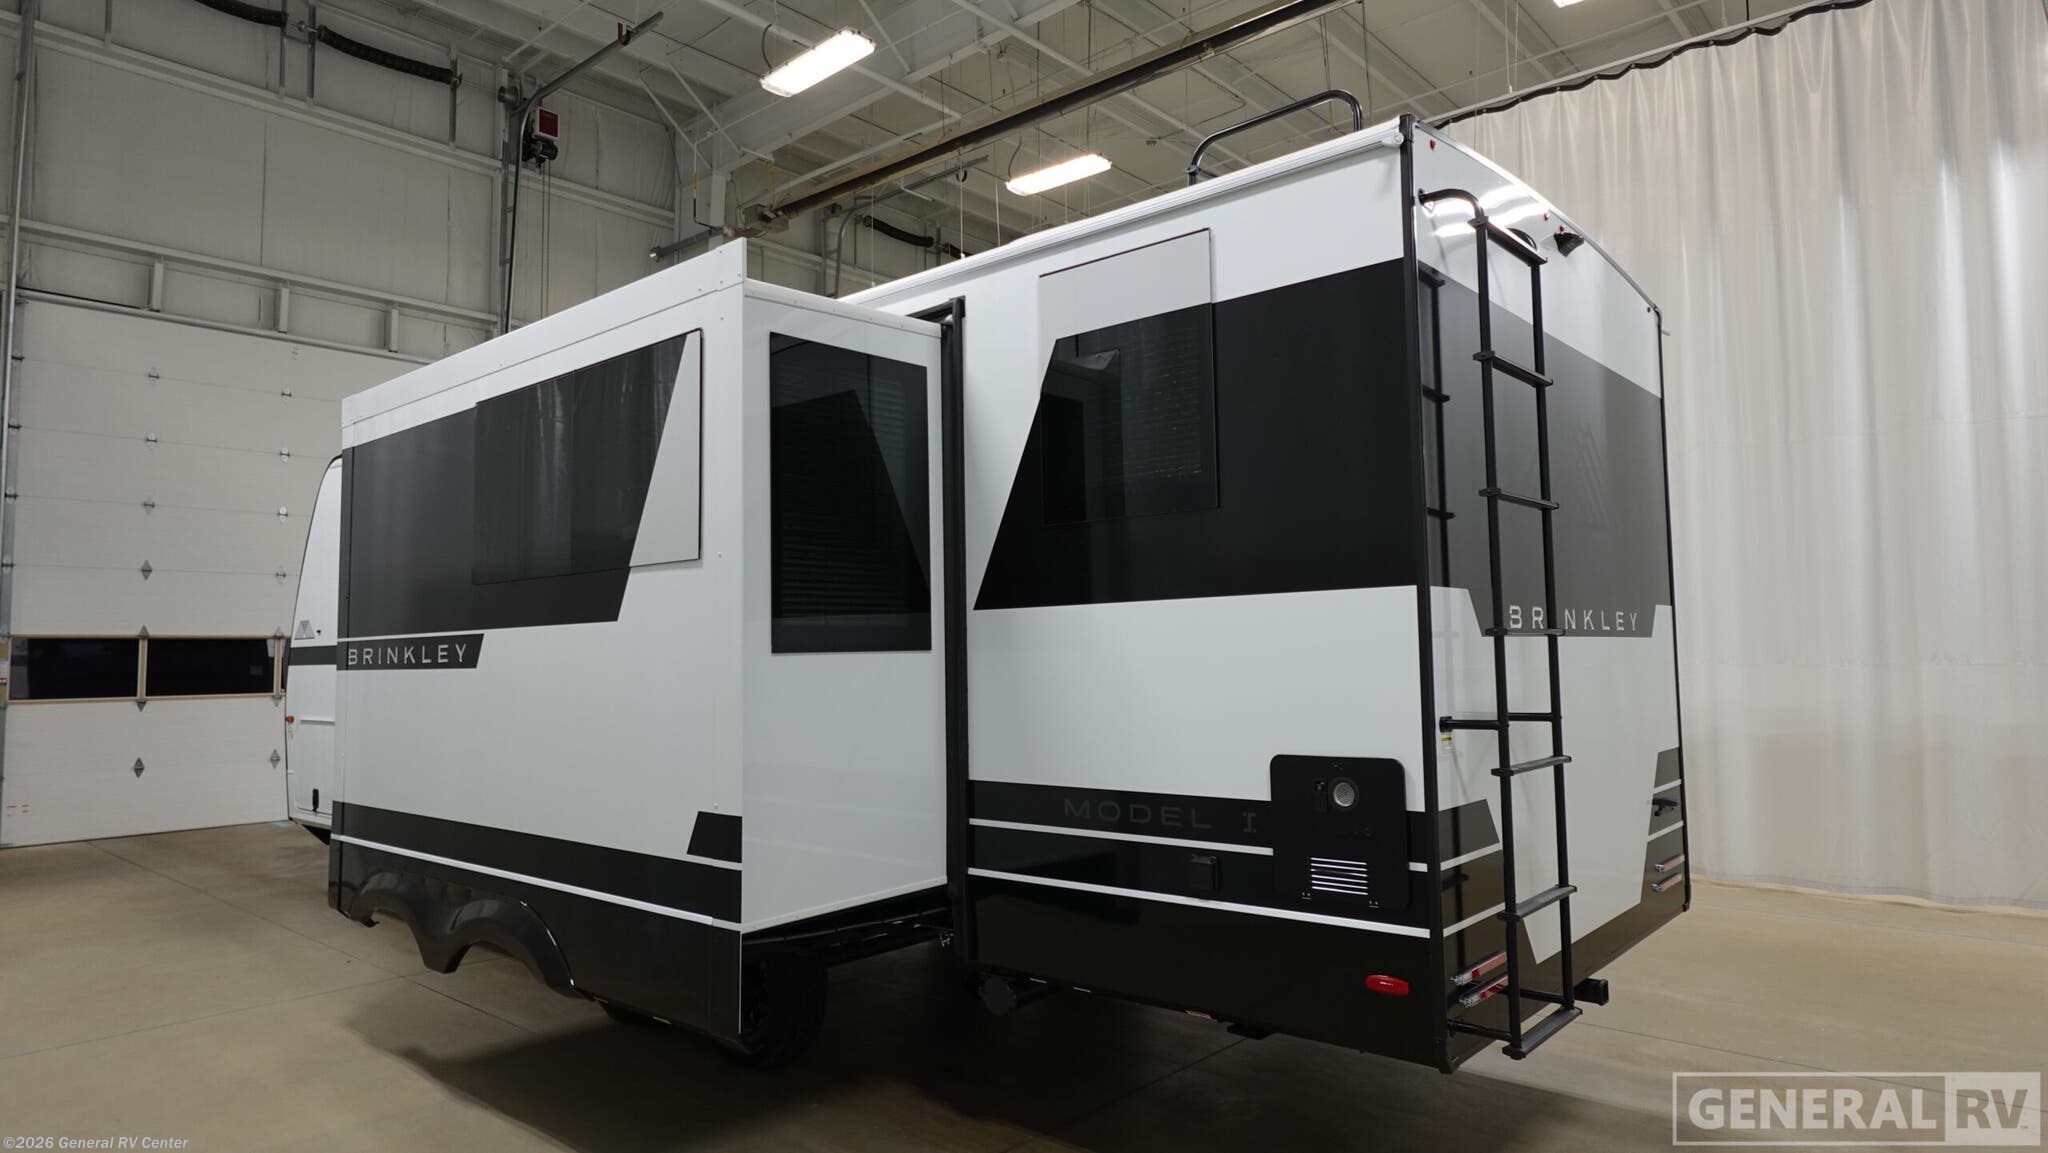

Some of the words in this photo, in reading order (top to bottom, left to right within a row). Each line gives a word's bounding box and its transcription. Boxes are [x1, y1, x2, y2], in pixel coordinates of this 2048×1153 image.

[1509, 605, 1637, 631] BRNKLEY
[348, 643, 467, 665] BRINKLEY
[1064, 798, 1212, 829] MODEL
